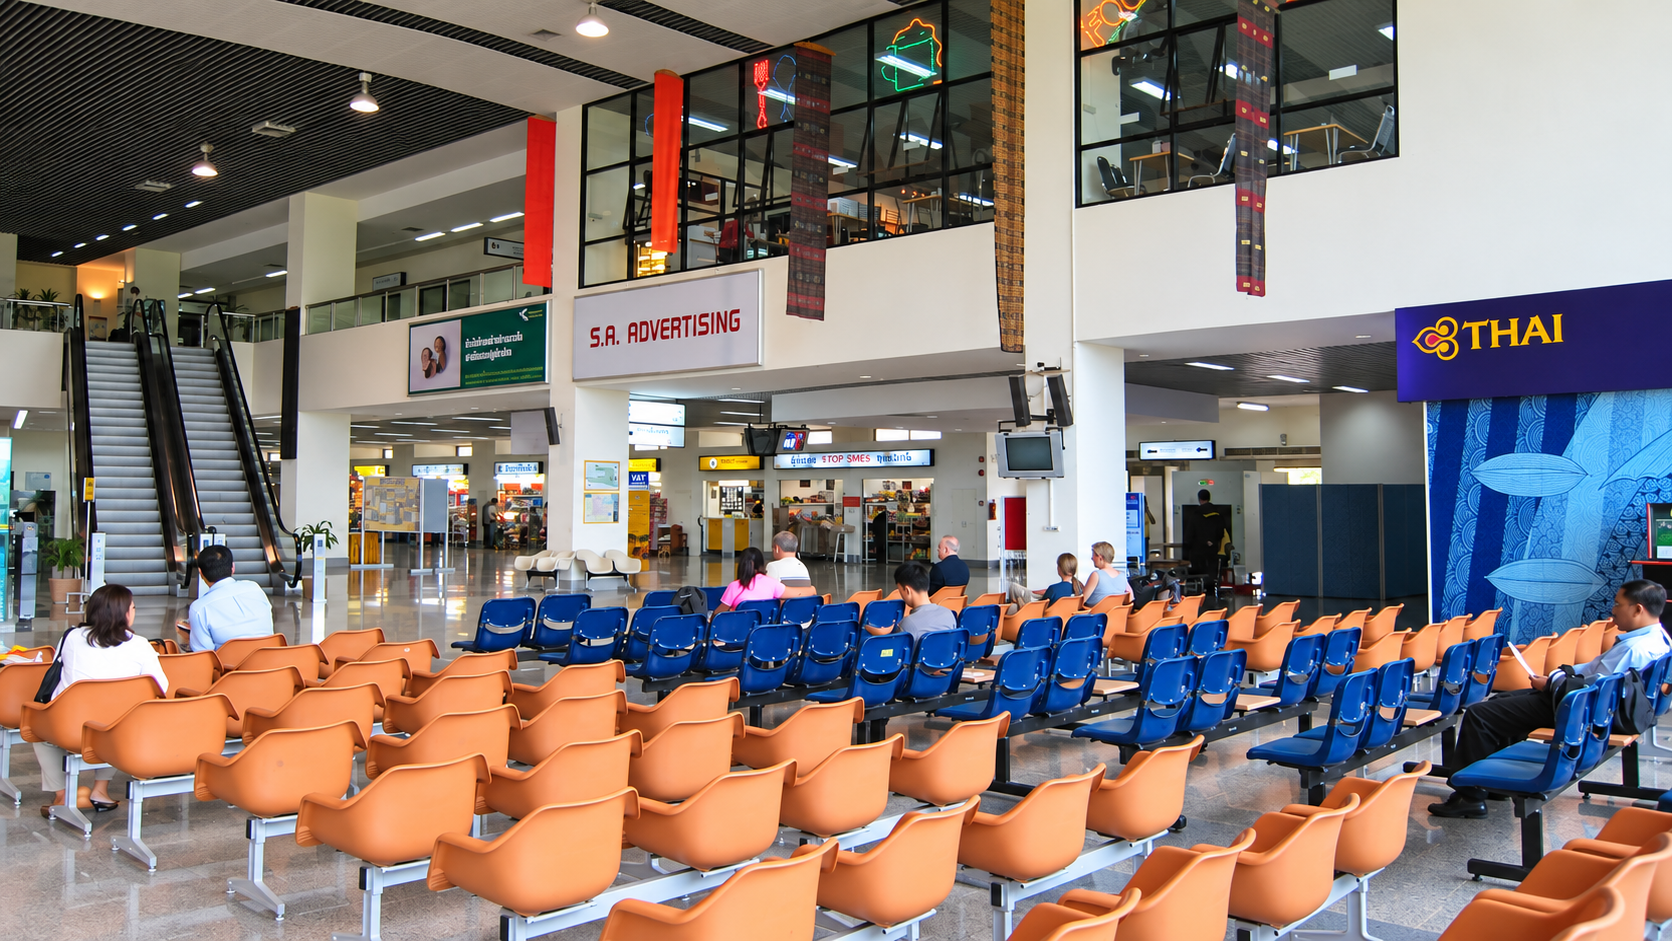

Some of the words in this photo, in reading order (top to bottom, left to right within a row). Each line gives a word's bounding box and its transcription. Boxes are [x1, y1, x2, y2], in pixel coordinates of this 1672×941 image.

[590, 325, 620, 348] S.A.
[628, 309, 741, 344] ADVERTISING
[1461, 313, 1564, 350] THAI
[822, 455, 844, 464] STOP
[846, 454, 871, 463] SMES
